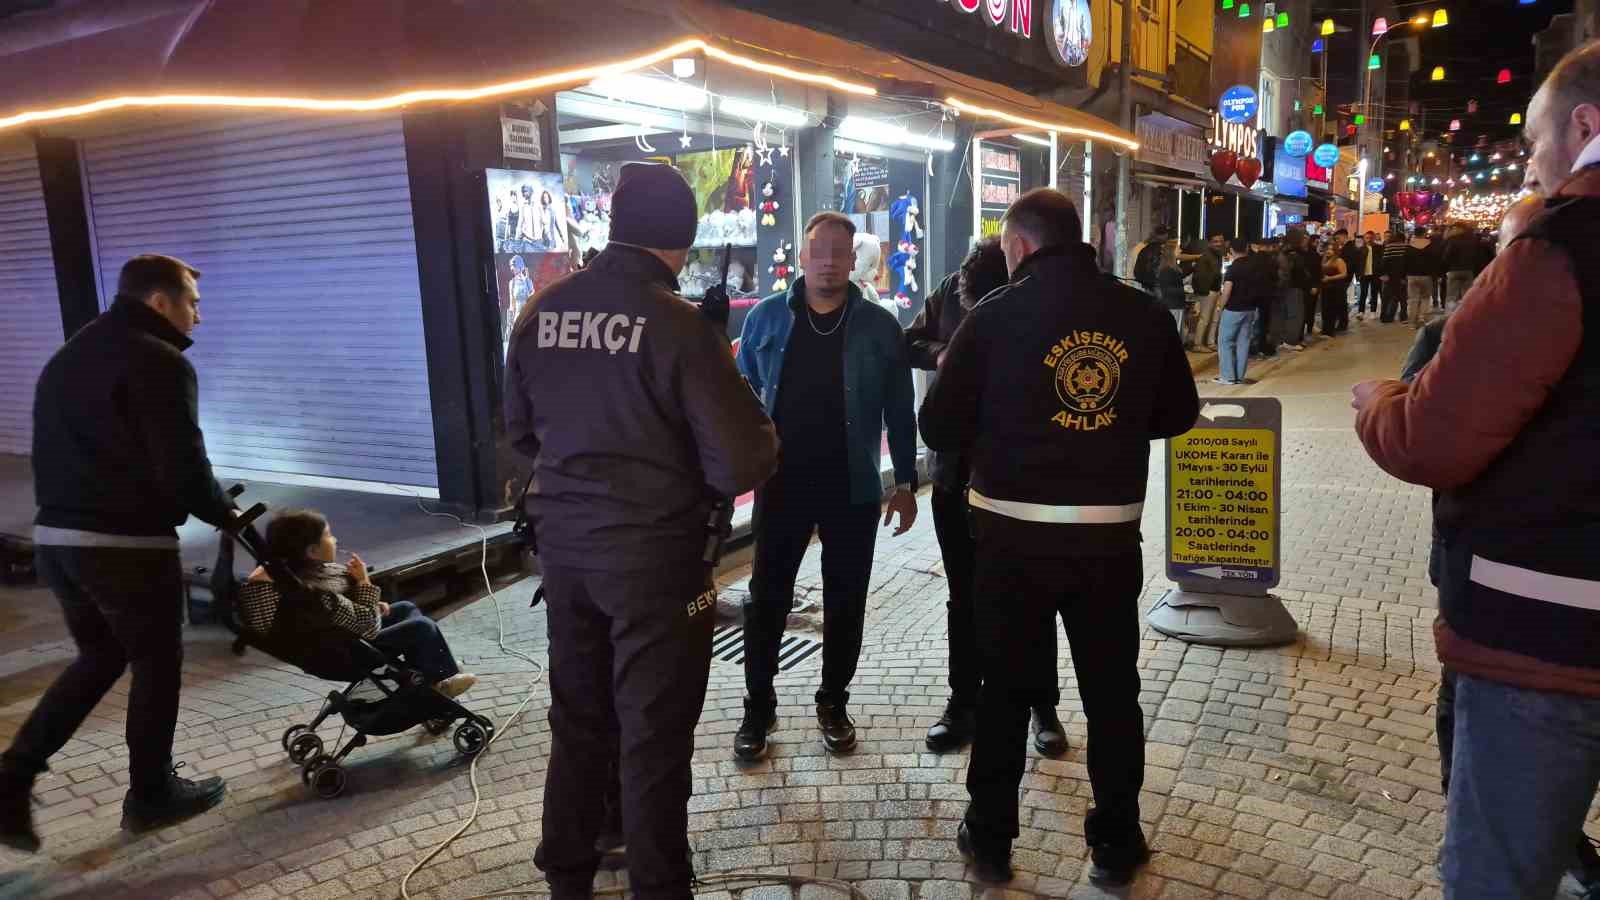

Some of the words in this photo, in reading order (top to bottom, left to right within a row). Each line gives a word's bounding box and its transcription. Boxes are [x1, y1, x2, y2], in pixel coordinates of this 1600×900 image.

[1051, 408, 1118, 431] AHLAK
[1232, 438, 1257, 449] Sayılı
[1175, 451, 1218, 460] UKOME
[1221, 451, 1254, 461] Kararı
[1256, 452, 1269, 461] ile
[1222, 463, 1238, 472] 30
[1241, 463, 1268, 473] Eylül
[1190, 477, 1255, 487] tarihlerinde
[1177, 489, 1214, 499] 21:00
[1224, 491, 1268, 501] 04:00
[1184, 504, 1210, 512] Ekim
[1219, 504, 1235, 513] 30
[1237, 505, 1269, 514] Nisan
[1188, 516, 1256, 526] tarihlerinde
[1175, 528, 1215, 538] 20:00
[1226, 529, 1269, 541] 04:00
[1187, 541, 1256, 553] Saatlerinde
